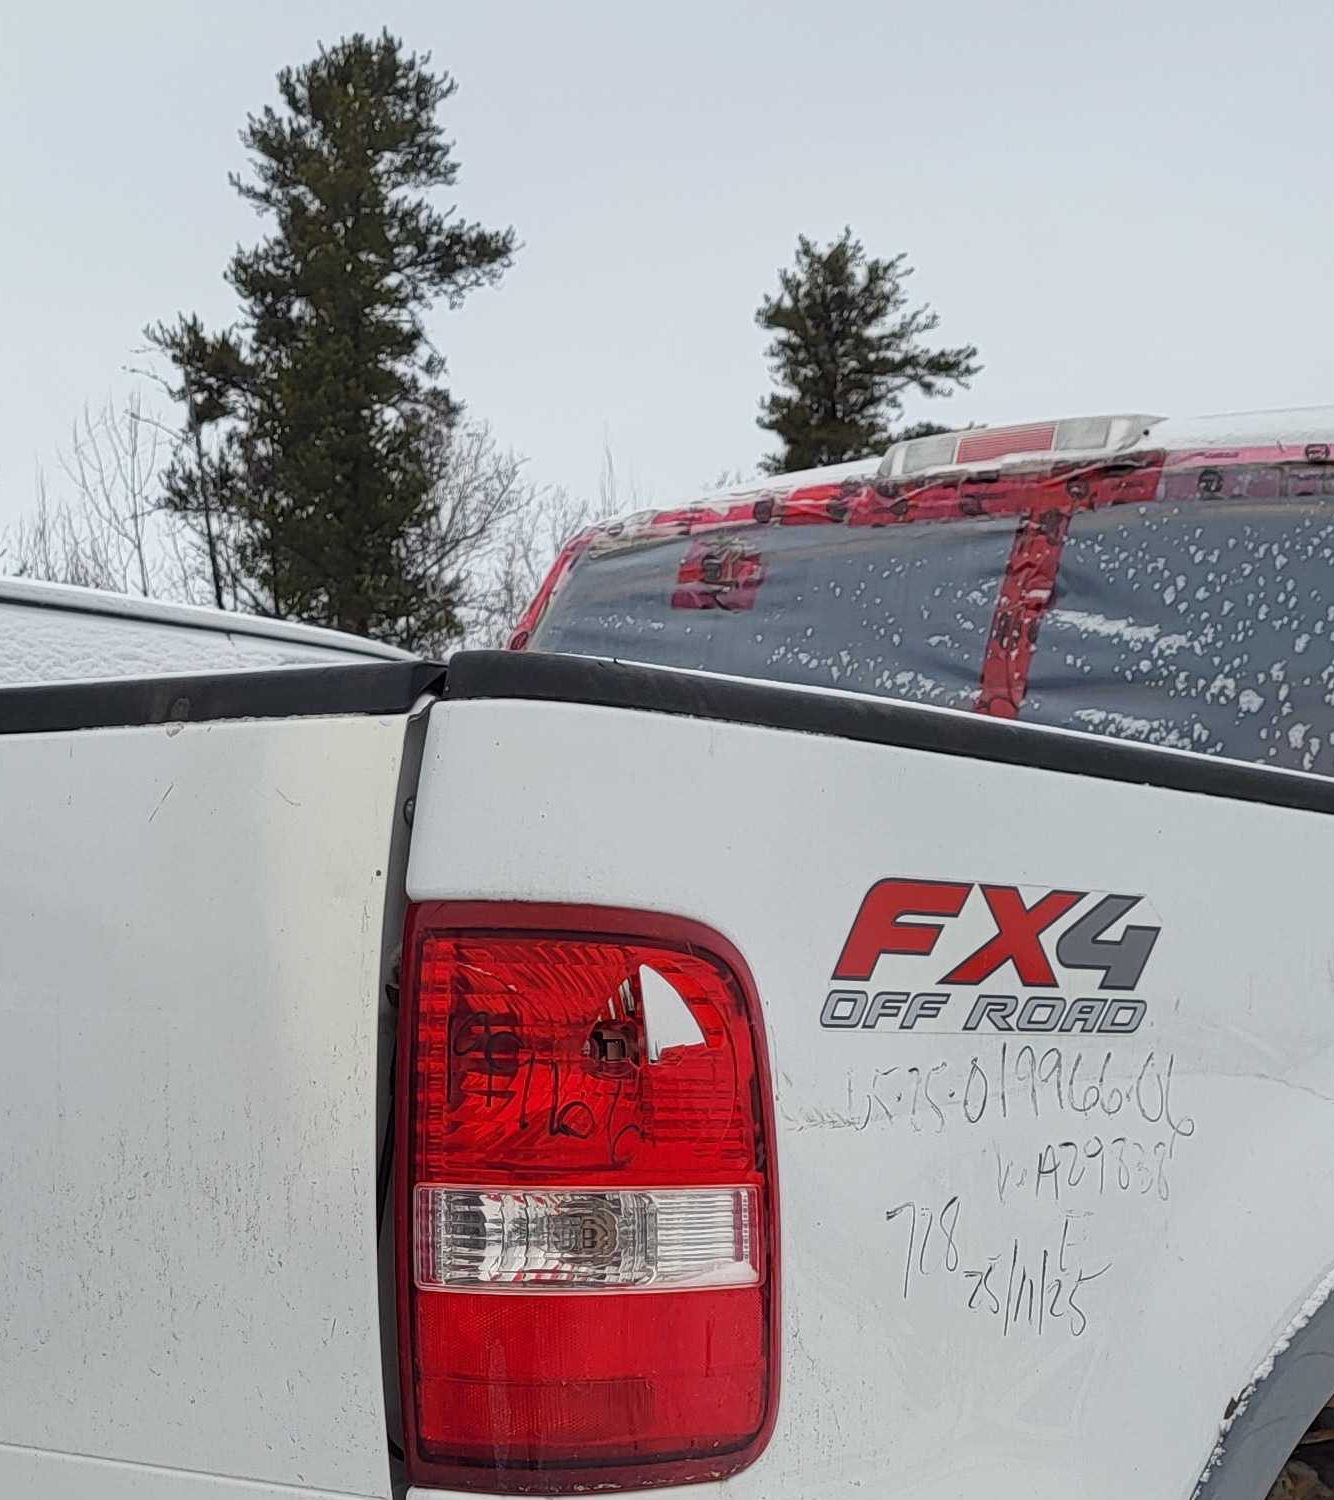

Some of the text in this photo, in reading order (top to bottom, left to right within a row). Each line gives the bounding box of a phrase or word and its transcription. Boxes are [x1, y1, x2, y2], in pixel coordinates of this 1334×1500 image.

[830, 877, 1162, 991] FX4
[819, 989, 1147, 1034] OFF ROAD
